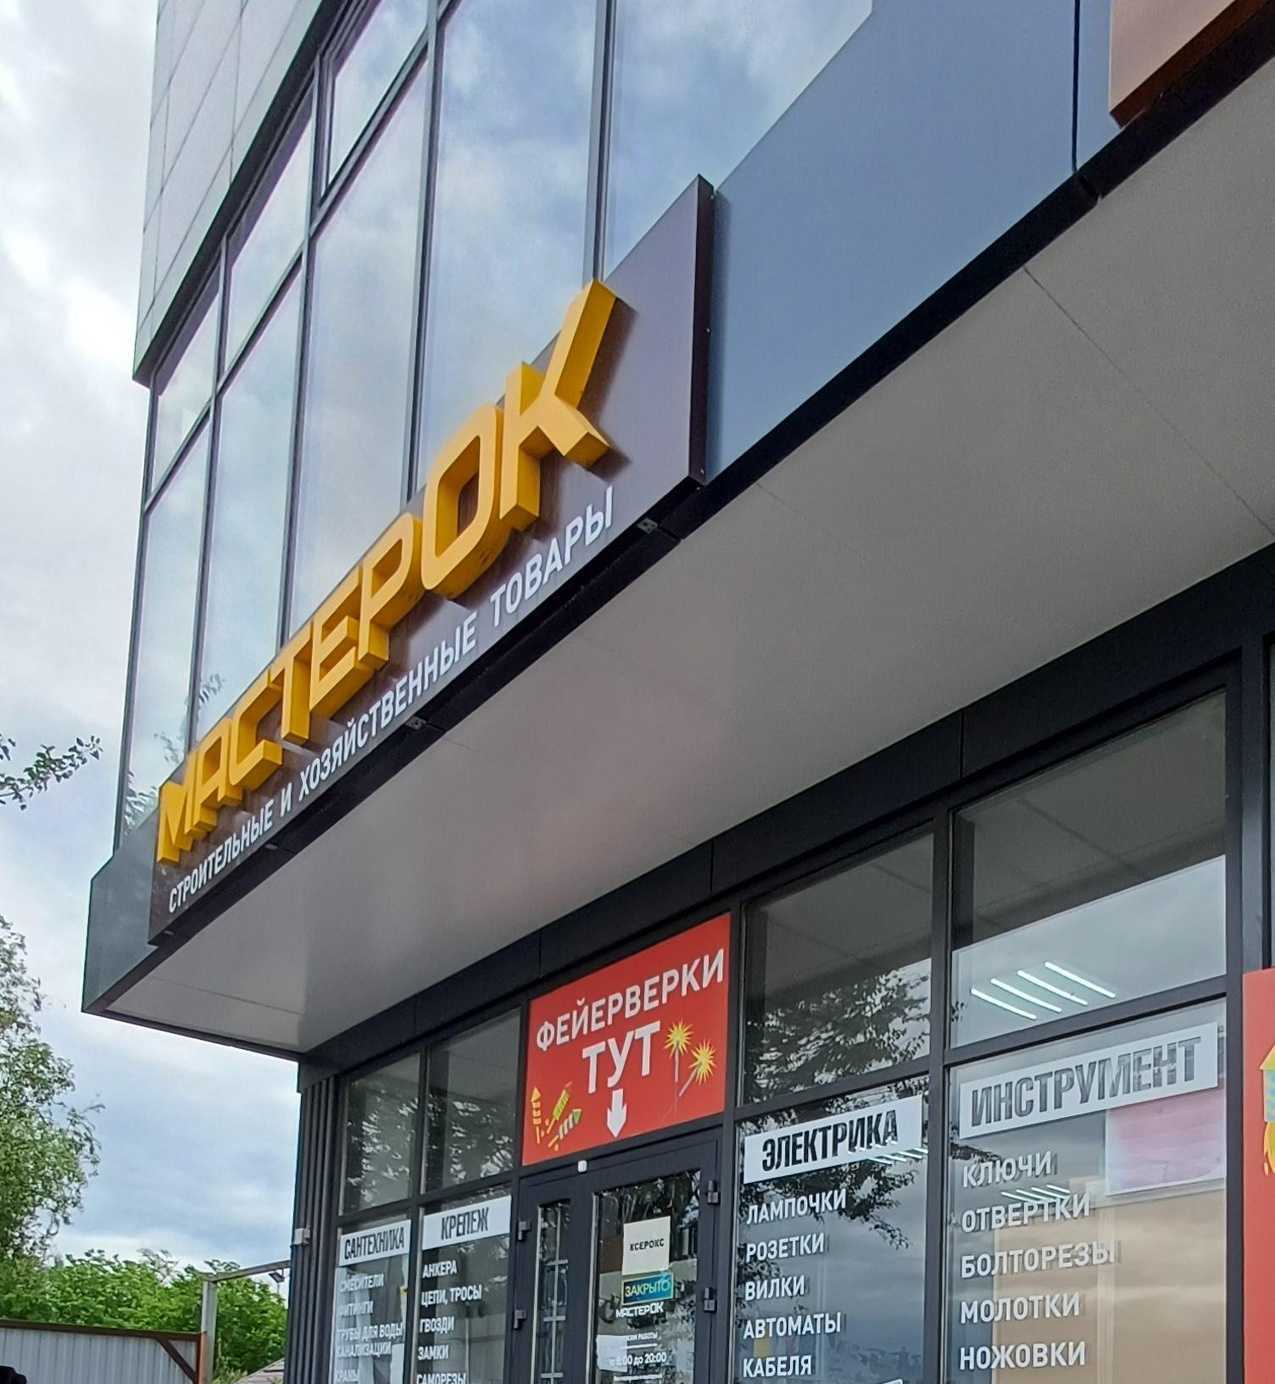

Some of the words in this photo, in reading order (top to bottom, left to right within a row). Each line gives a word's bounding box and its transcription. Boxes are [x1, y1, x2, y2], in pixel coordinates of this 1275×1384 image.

[157, 278, 616, 863] МАСТЕРОК
[169, 800, 275, 913] СТРОИТЕЛЬНЫЕ
[280, 782, 292, 816] И
[299, 612, 478, 800] ХОЗЯЙСТВЕННЫЕ
[490, 486, 614, 627] ТОВАРЫ
[536, 948, 724, 1052] ФЕЙЕРВЕРКИ
[582, 1020, 661, 1094] ТУТ
[971, 1037, 1201, 1127] ИНСТРУМЕНТ
[762, 1109, 898, 1172] ЭЛЕКТРИКА
[963, 1151, 1052, 1188] КЛЮЧИ
[746, 1188, 846, 1225] ЛАМПОЧКИ
[961, 1192, 1091, 1233] ОТВЕРТКИ
[441, 1207, 489, 1240] КРЕПЕЖ
[344, 1227, 405, 1259] САНТЕХНИКА
[746, 1233, 825, 1263] РОЗЕТКИ
[422, 1260, 457, 1278] АНКЕРА
[961, 1240, 1116, 1279] БОЛТОРЕЗЫ
[450, 1284, 482, 1302] ТРОСЫ
[624, 1280, 671, 1298] ЗАКРЫТО
[745, 1275, 805, 1302] ВИЛКИ
[616, 1302, 664, 1318] МАСТЕРОК
[960, 1292, 1081, 1324] МОЛОТКИ
[379, 1323, 403, 1339] ВОДЫ
[420, 1316, 454, 1333] ГВОЗДИ
[743, 1312, 841, 1339] АВТОМАТЫ
[418, 1345, 449, 1360] ЗАМКИ
[645, 1352, 667, 1364] 20:00
[743, 1355, 812, 1378] КАБЕЛЯ
[959, 1341, 1086, 1371] НОЖОВКИ
